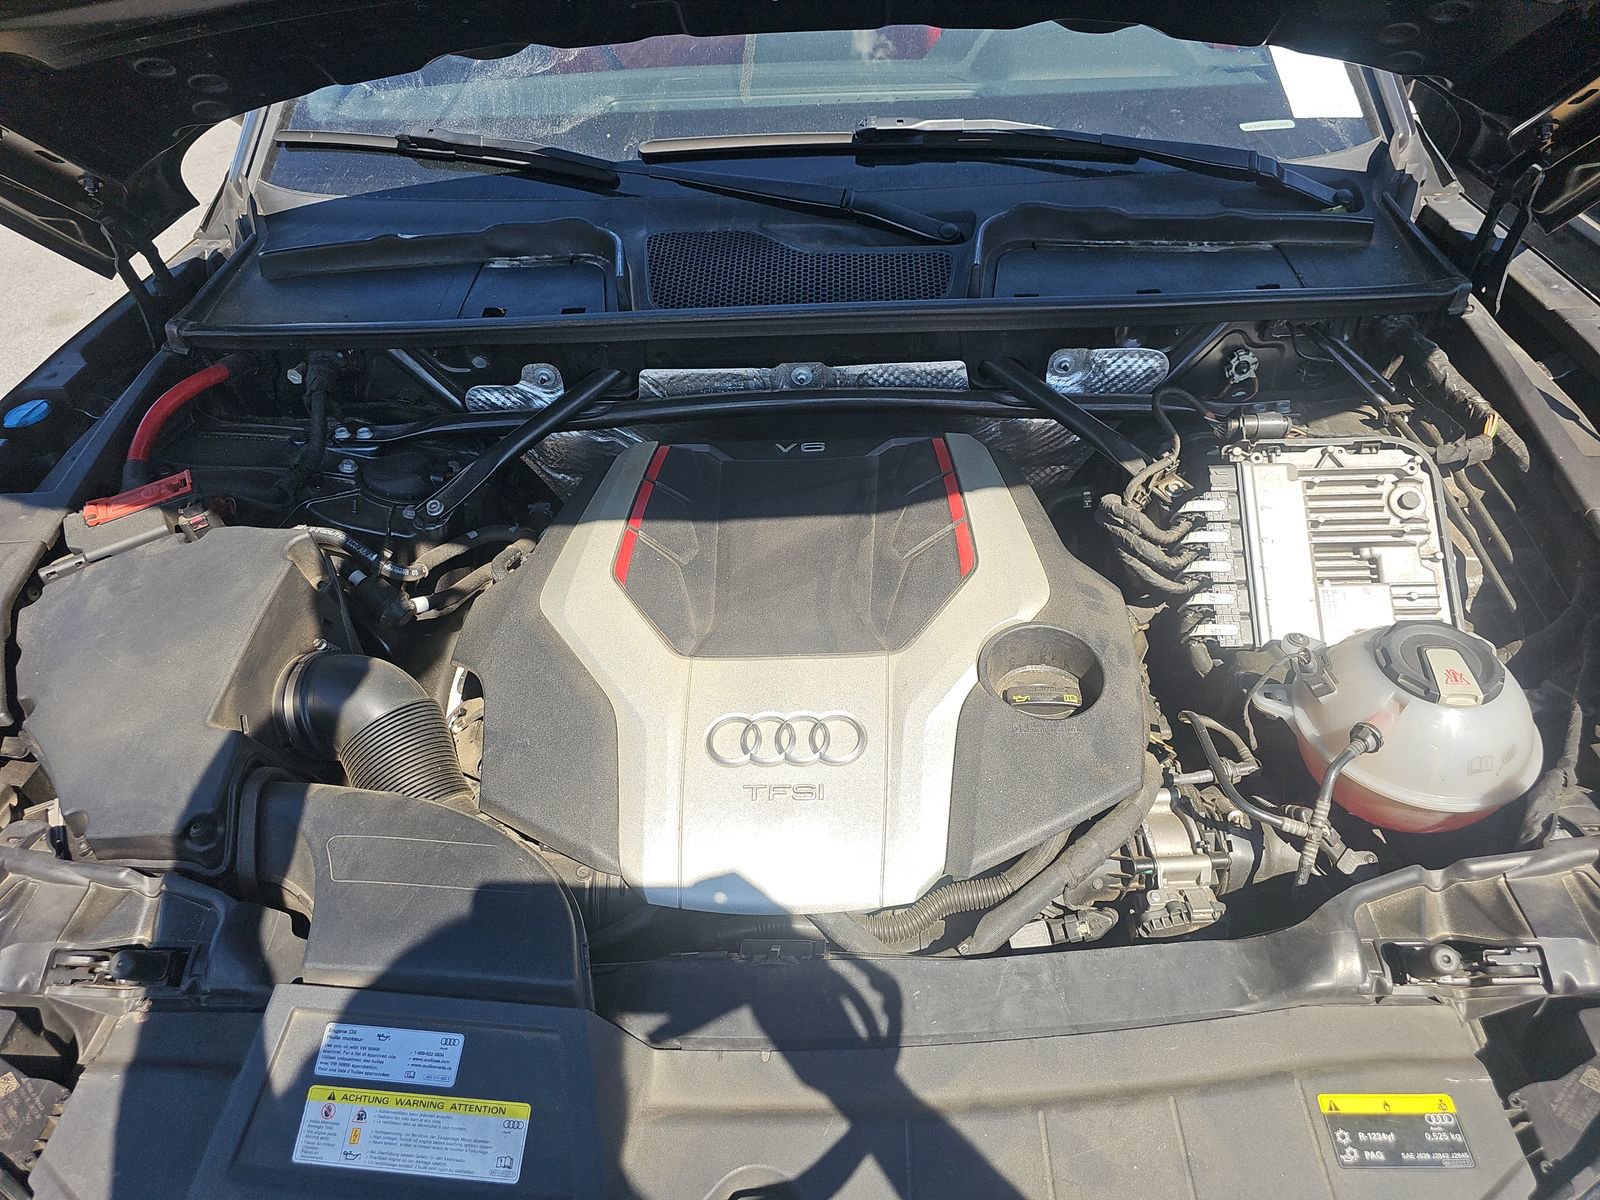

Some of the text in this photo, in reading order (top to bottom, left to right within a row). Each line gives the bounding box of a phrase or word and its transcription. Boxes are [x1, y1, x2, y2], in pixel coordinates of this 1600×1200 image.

[775, 442, 825, 453] V6
[743, 783, 824, 801] TFSI
[341, 1093, 506, 1115] ACHTUNG WARNING ATTENTION
[1357, 1131, 1396, 1142] R-1234yf
[1450, 1131, 1462, 1142] kg
[1364, 1150, 1386, 1160] PAG
